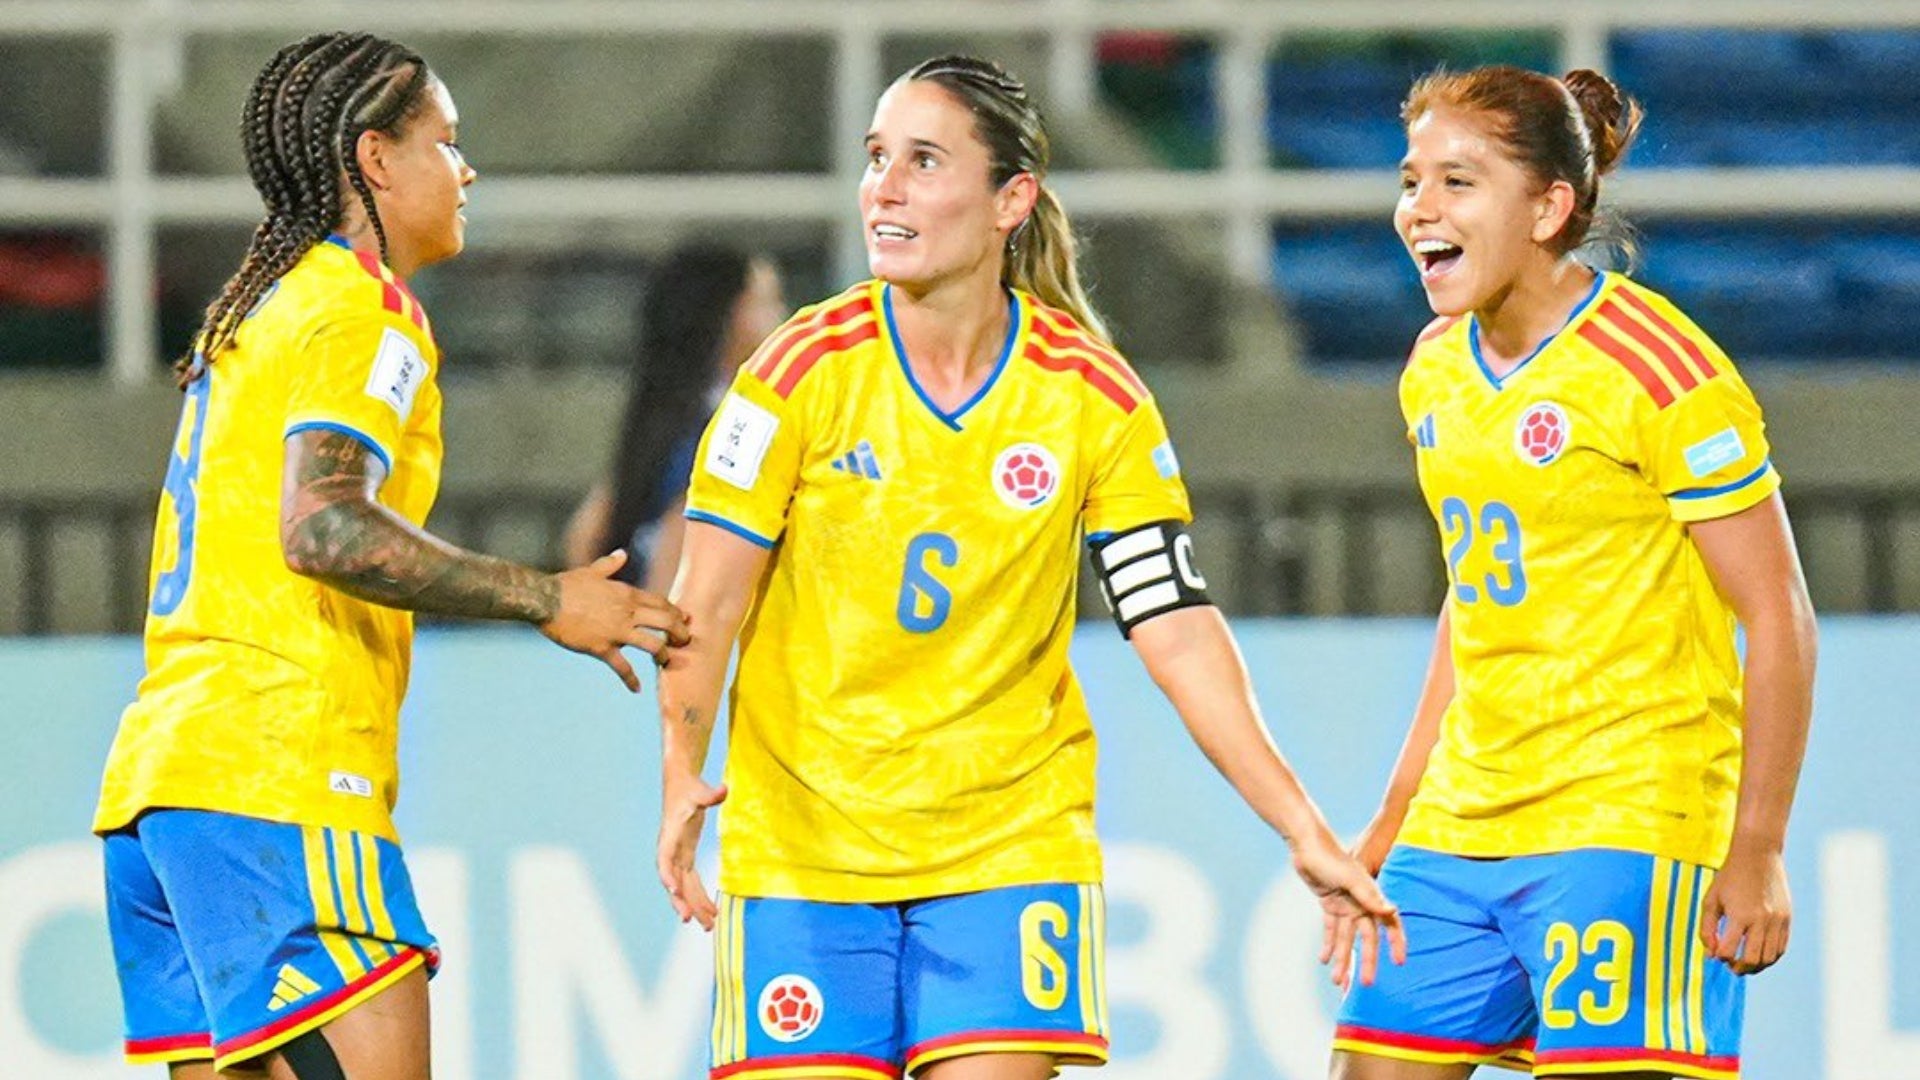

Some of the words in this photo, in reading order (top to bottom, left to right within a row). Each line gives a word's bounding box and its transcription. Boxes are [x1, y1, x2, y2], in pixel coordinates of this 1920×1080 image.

[897, 532, 958, 634] 6
[1174, 533, 1206, 590] C
[1442, 497, 1527, 606] 23
[1020, 901, 1068, 1010] 6
[1543, 920, 1634, 1029] 23
